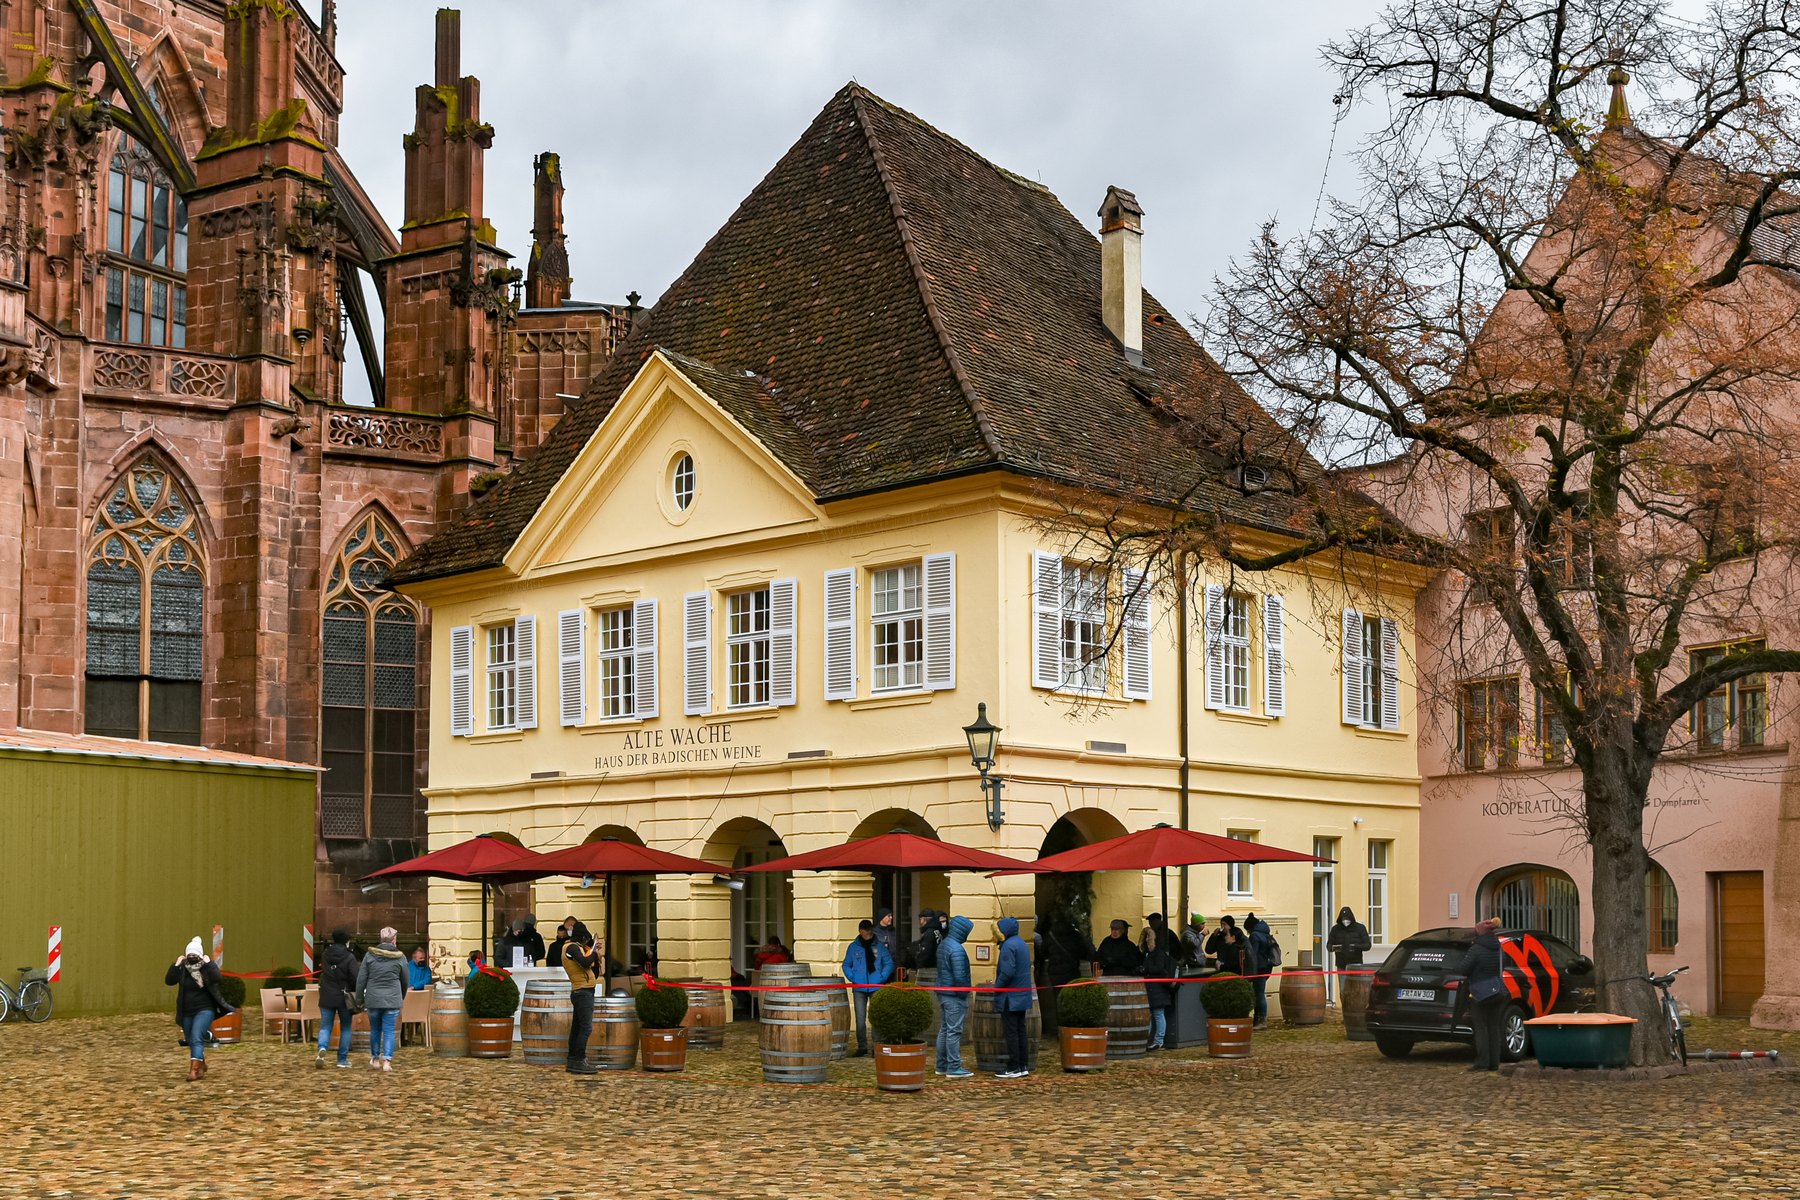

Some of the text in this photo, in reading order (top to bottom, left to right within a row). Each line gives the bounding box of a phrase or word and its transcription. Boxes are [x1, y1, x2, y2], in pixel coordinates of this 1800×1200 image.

[623, 724, 732, 750] ALTE WACHE
[595, 745, 762, 769] HAUS DER BADISCHEN WEINE
[1482, 798, 1571, 816] KOOPERATUR
[1653, 796, 1701, 808] Dompfarrei
